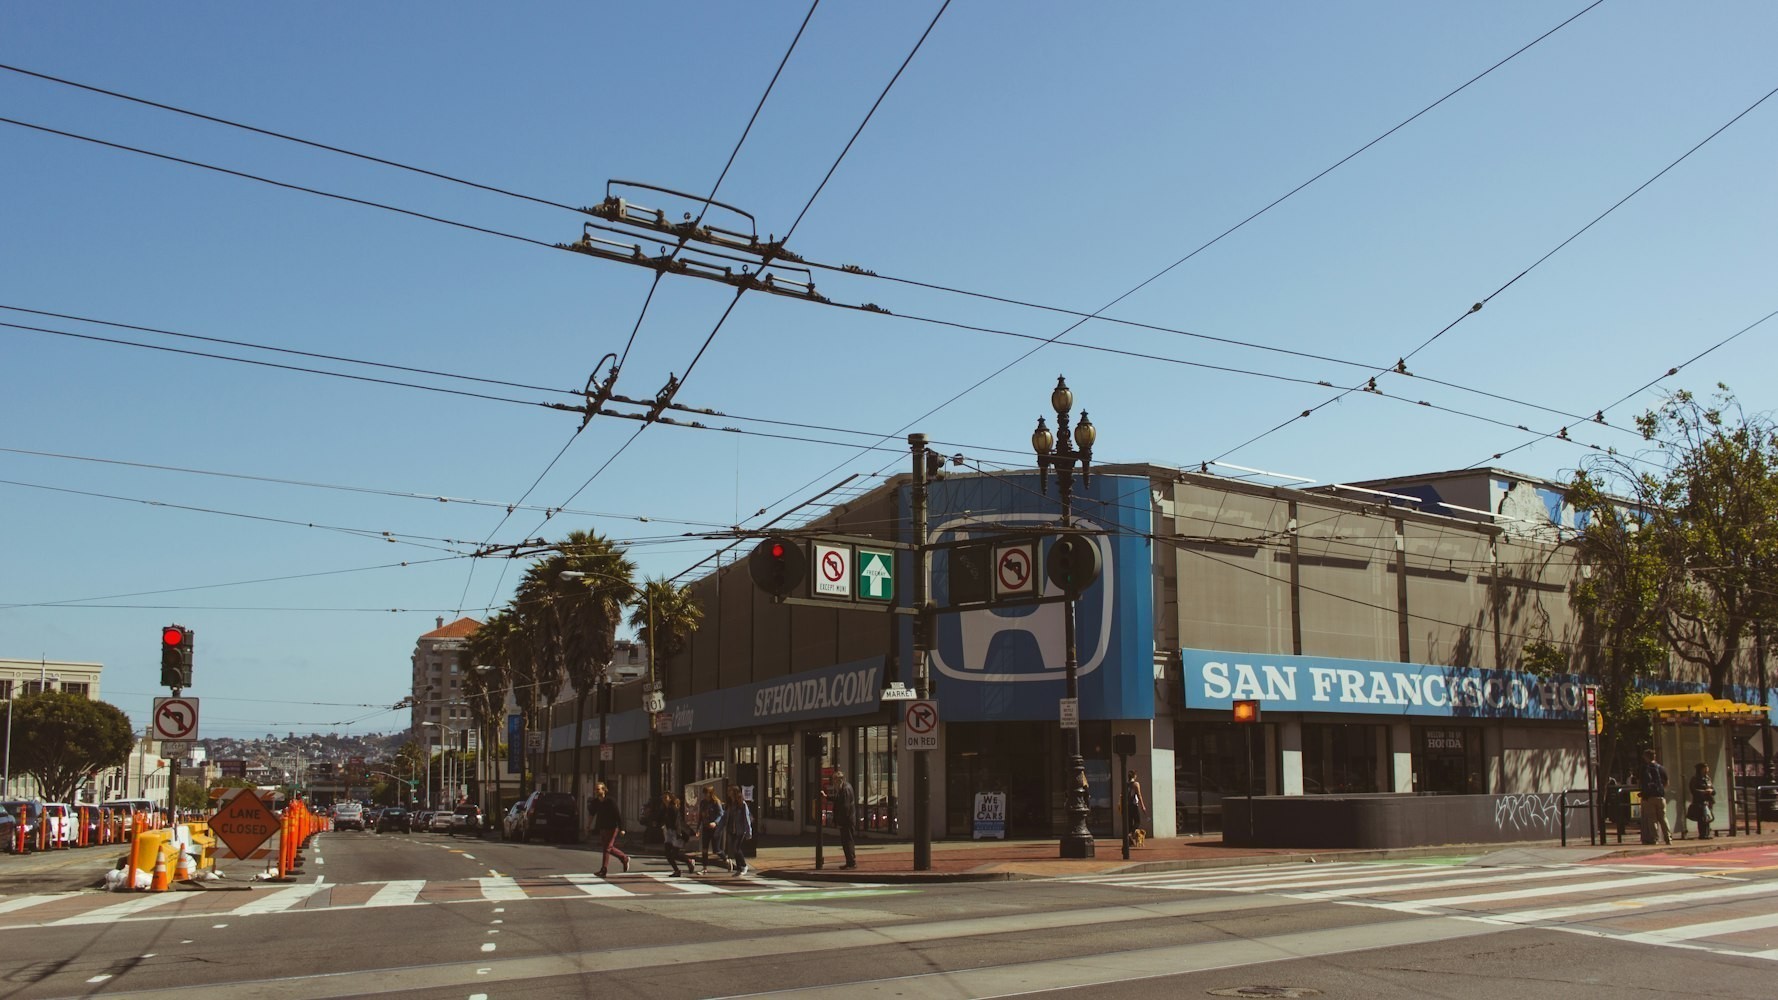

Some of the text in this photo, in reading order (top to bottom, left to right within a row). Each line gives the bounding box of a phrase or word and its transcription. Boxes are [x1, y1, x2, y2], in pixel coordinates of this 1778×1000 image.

[866, 569, 886, 577] FREEWAY
[819, 583, 847, 593] EXCEPT MUNI
[1202, 661, 1297, 701] SAN
[1309, 667, 1529, 710] FRANCISCO
[753, 667, 877, 717] SFHONDA.COM
[886, 690, 914, 698] MARKET
[645, 698, 662, 711] 101
[908, 737, 936, 746] ON RED
[983, 795, 998, 804] WE
[981, 803, 999, 812] BUY
[229, 808, 261, 820] LANE
[976, 811, 1003, 820] CARS
[221, 823, 267, 835] CLOSED
